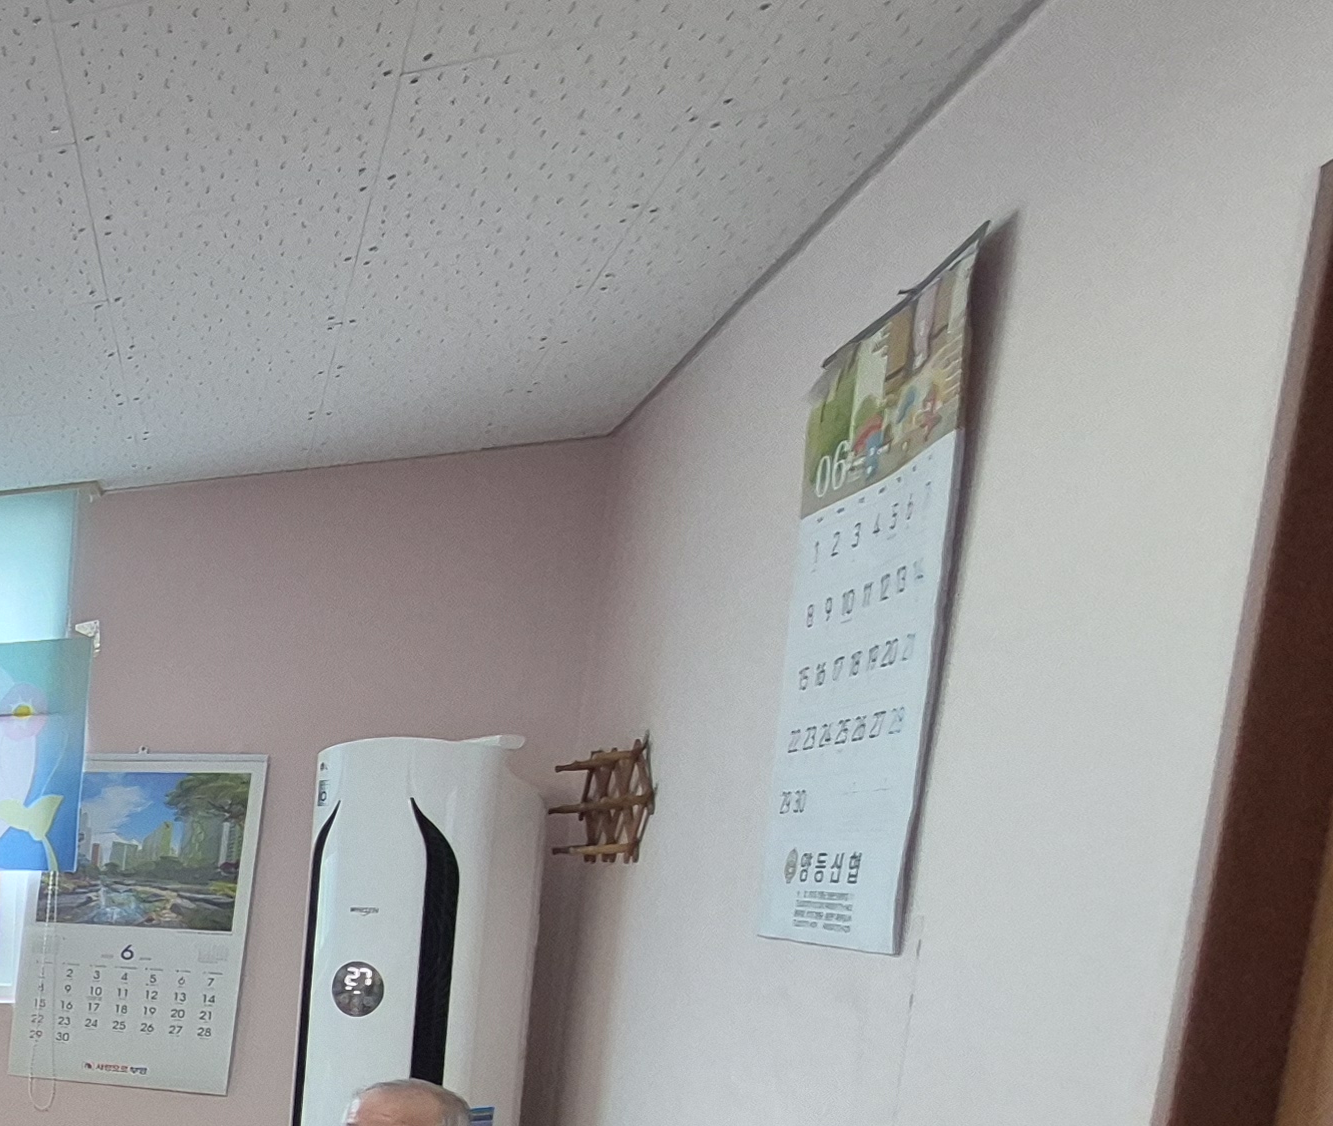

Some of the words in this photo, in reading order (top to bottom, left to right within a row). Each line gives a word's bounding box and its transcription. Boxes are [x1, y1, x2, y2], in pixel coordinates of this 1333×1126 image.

[815, 440, 848, 498] 06
[830, 531, 841, 557] 2
[851, 522, 862, 548] 3
[806, 604, 815, 628] 8
[825, 597, 833, 622] 9
[841, 589, 855, 616] 10
[120, 944, 134, 961] 6
[65, 969, 74, 978] 2
[93, 970, 101, 980] 3
[120, 972, 128, 982] 4
[149, 974, 157, 984] 5
[177, 976, 186, 986] 6
[207, 978, 215, 987] 7
[344, 966, 373, 987] 27
[64, 985, 72, 994] 9
[89, 986, 103, 997] 10
[117, 988, 129, 998] 11
[145, 990, 158, 1000] 12
[174, 992, 187, 1002] 13
[203, 994, 216, 1004] 14
[60, 1000, 73, 1010] 16
[87, 1002, 101, 1012] 17
[115, 1004, 128, 1015] 18
[143, 1006, 157, 1016] 19
[170, 1009, 185, 1019] 20
[199, 1011, 212, 1021] 21
[55, 1032, 70, 1042] 30
[57, 1016, 71, 1026] 23
[84, 1018, 98, 1028] 24
[112, 1020, 126, 1030] 25
[140, 1022, 155, 1033] 26
[169, 1025, 183, 1035] 27
[197, 1027, 212, 1038] 28
